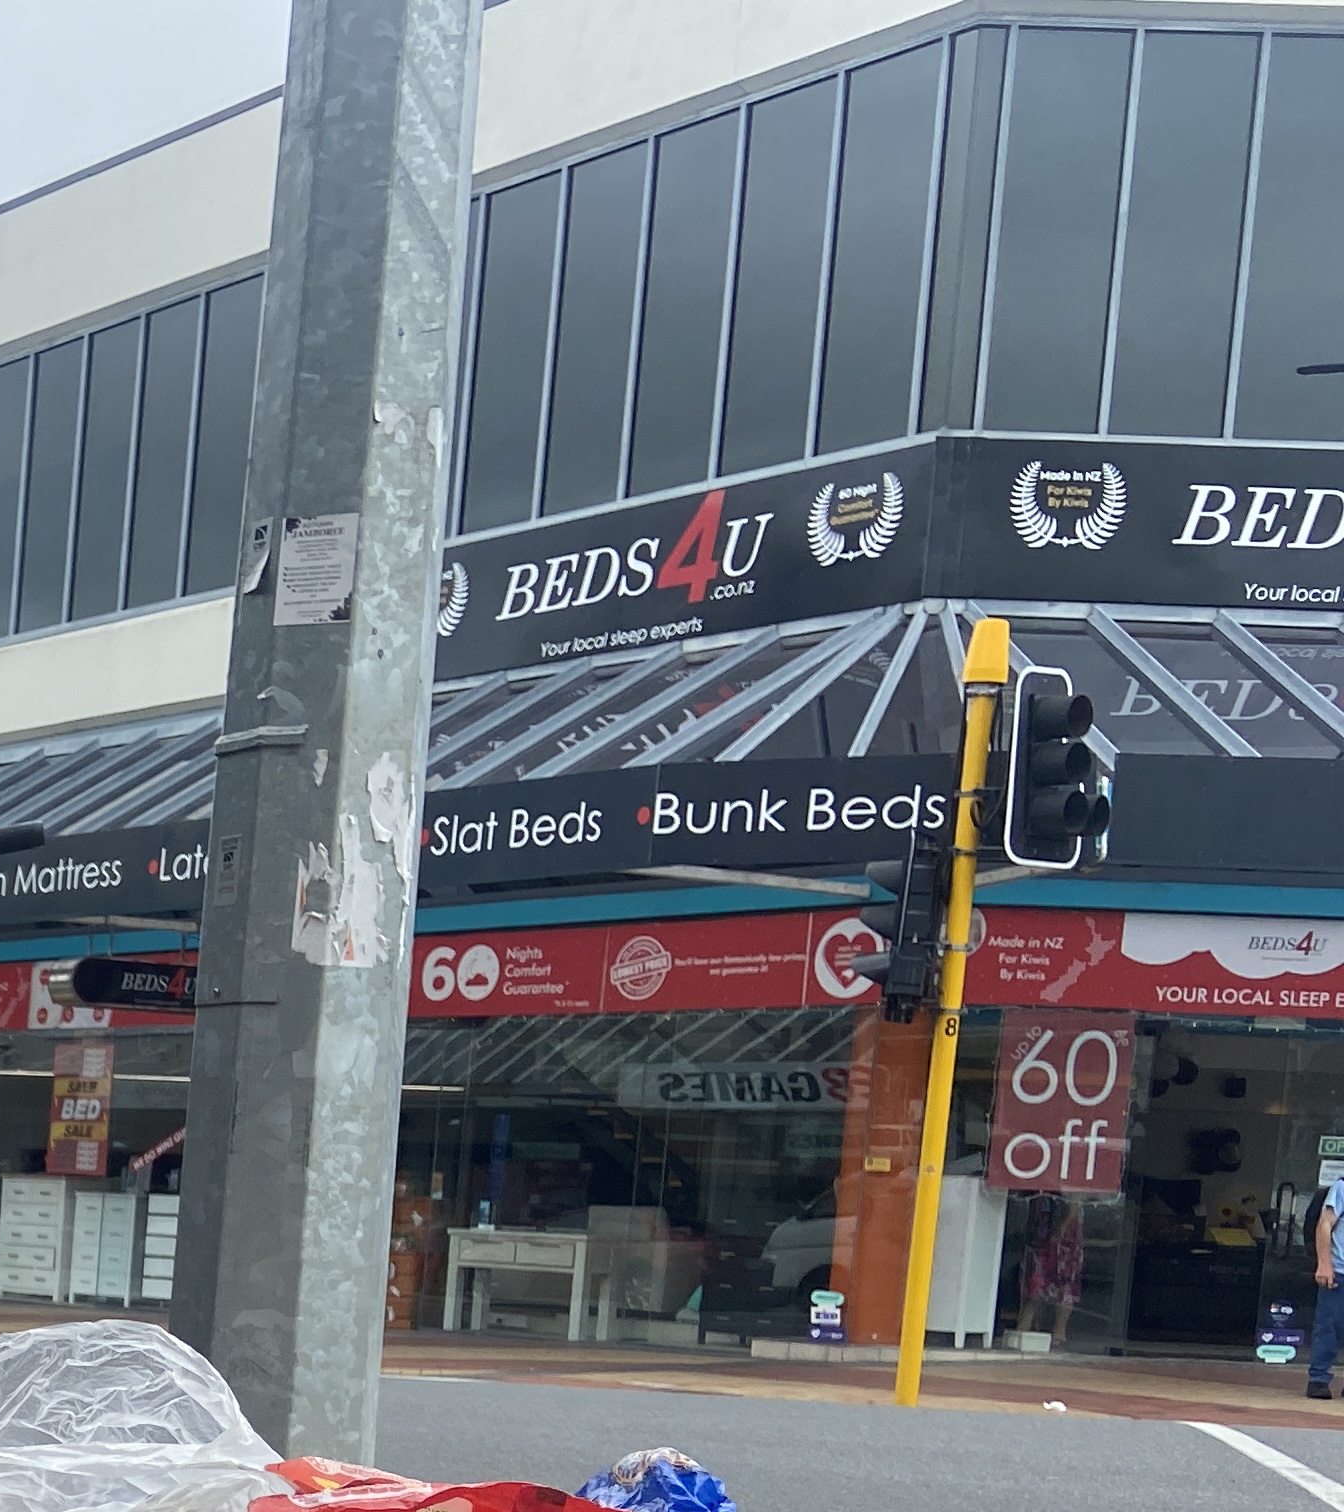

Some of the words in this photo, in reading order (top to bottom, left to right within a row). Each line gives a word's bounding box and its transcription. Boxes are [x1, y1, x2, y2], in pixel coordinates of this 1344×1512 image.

[1040, 470, 1071, 482] Made
[1085, 470, 1103, 482] NZ
[495, 489, 775, 621] BEDS4U
[1243, 582, 1288, 602] Your
[1291, 585, 1340, 604] local
[540, 640, 570, 658] Your
[573, 631, 609, 652] local
[610, 628, 649, 646] sleep
[649, 615, 705, 641] experts
[652, 789, 788, 836] Bunk
[806, 784, 947, 832] Beds
[430, 811, 498, 857] Slat
[509, 801, 603, 850] Beds
[14, 856, 123, 897] Mattress
[988, 934, 1026, 950] Made
[1028, 935, 1041, 950] in
[1044, 936, 1065, 950] NZ
[1247, 930, 1329, 956] BEDS4U
[504, 963, 553, 979] Comfort
[998, 952, 1018, 966] For
[1020, 953, 1051, 967] Kiwis
[120, 966, 196, 999] BEDS4U
[421, 944, 501, 1001] 60
[505, 946, 544, 963] Nights
[999, 968, 1014, 982] By
[1016, 967, 1046, 982] Kiwis
[1155, 985, 1208, 1004] YOUR
[1213, 987, 1274, 1005] LOCAL
[1279, 990, 1330, 1008] SLEEP
[944, 1017, 957, 1037] 8
[60, 1098, 102, 1121] BED
[63, 1124, 94, 1138] SALE
[1003, 1119, 1110, 1181] off
